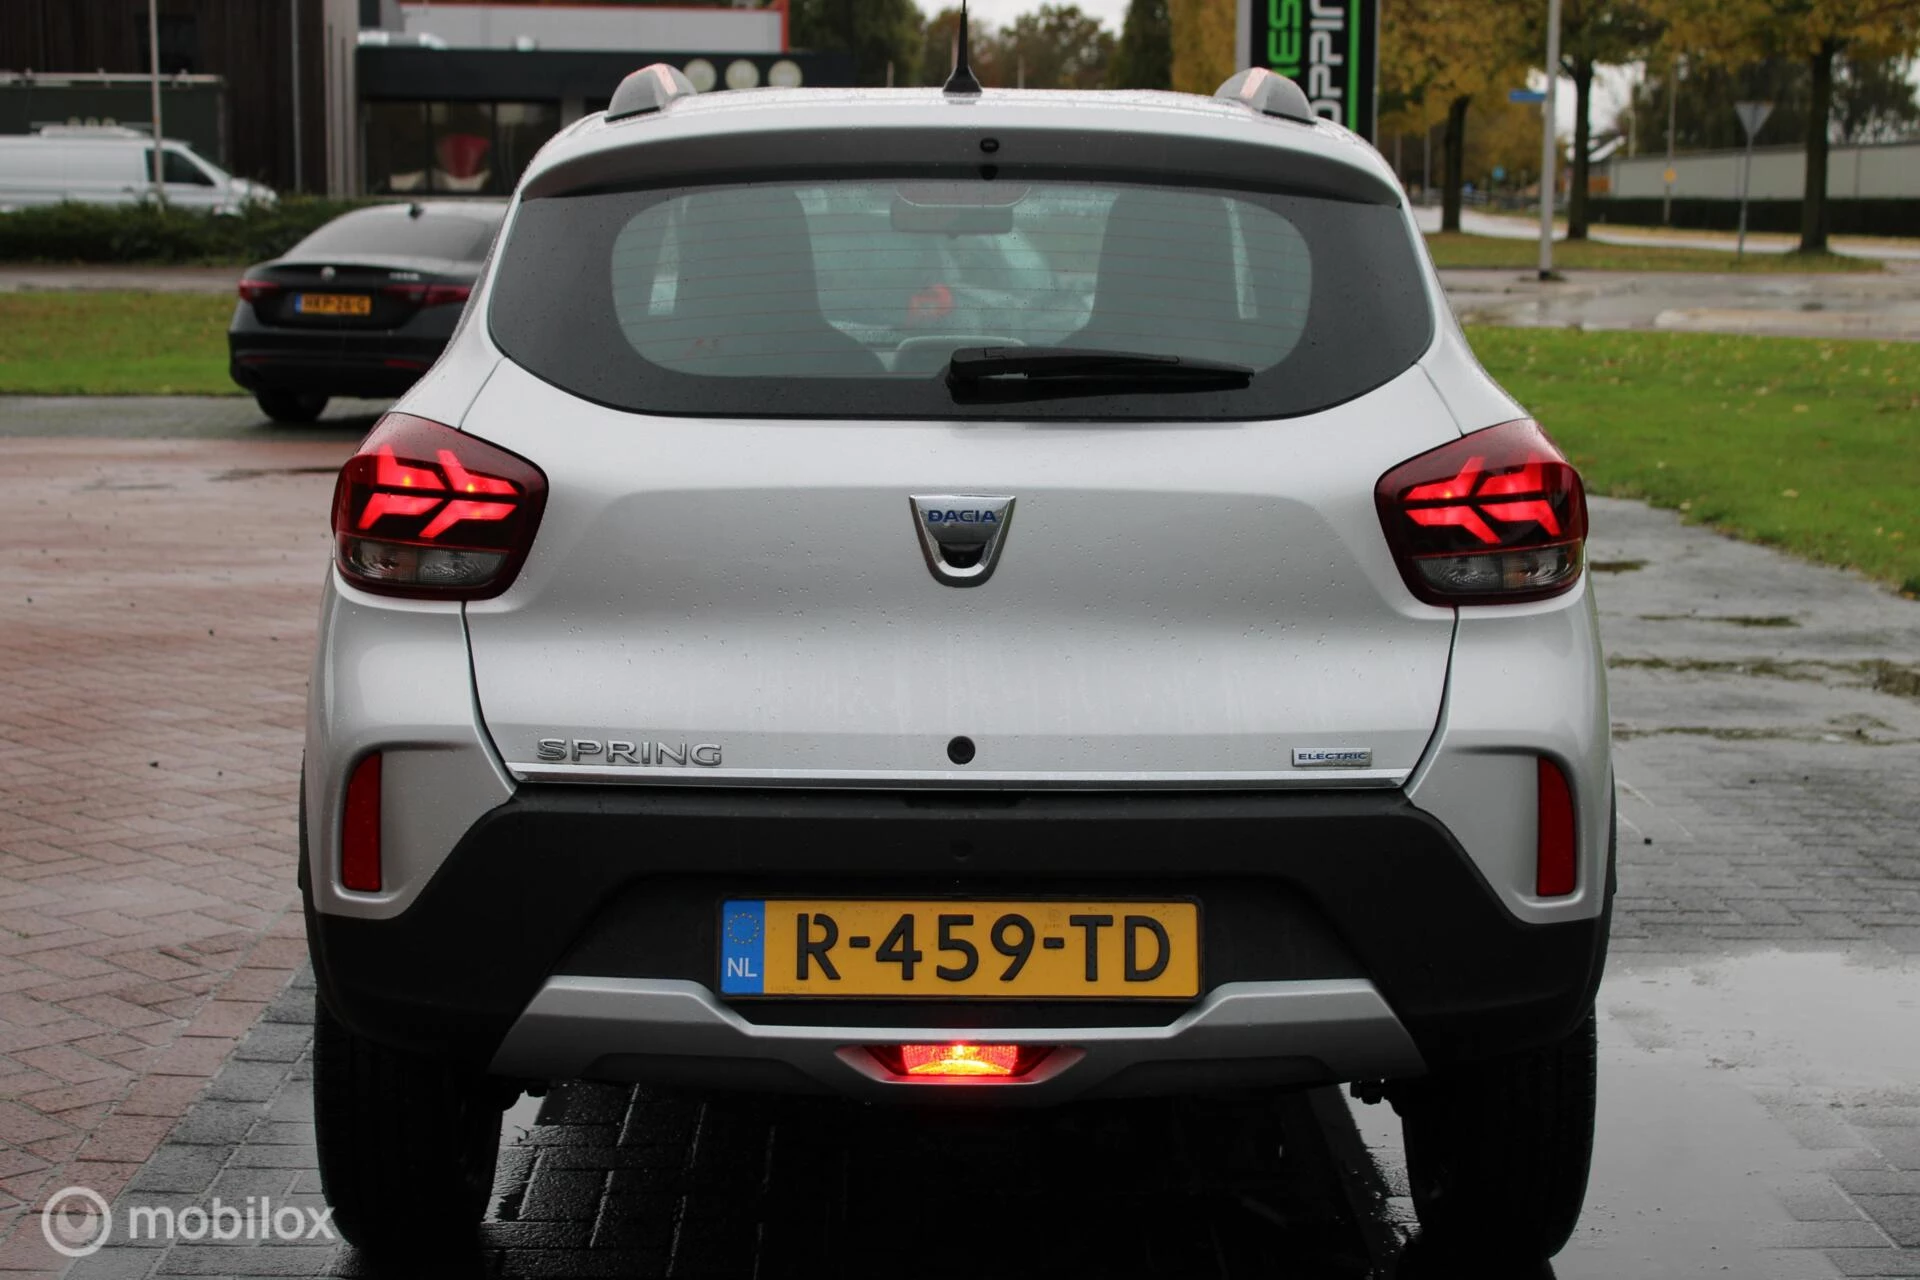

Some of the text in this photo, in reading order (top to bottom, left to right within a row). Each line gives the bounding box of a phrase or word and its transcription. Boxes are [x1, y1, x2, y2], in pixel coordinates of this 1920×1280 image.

[927, 509, 997, 523] DACIA
[537, 738, 722, 766] SPRING
[1298, 751, 1369, 760] ELECTRIC
[796, 913, 1171, 982] R-459-TD
[727, 957, 757, 978] NL
